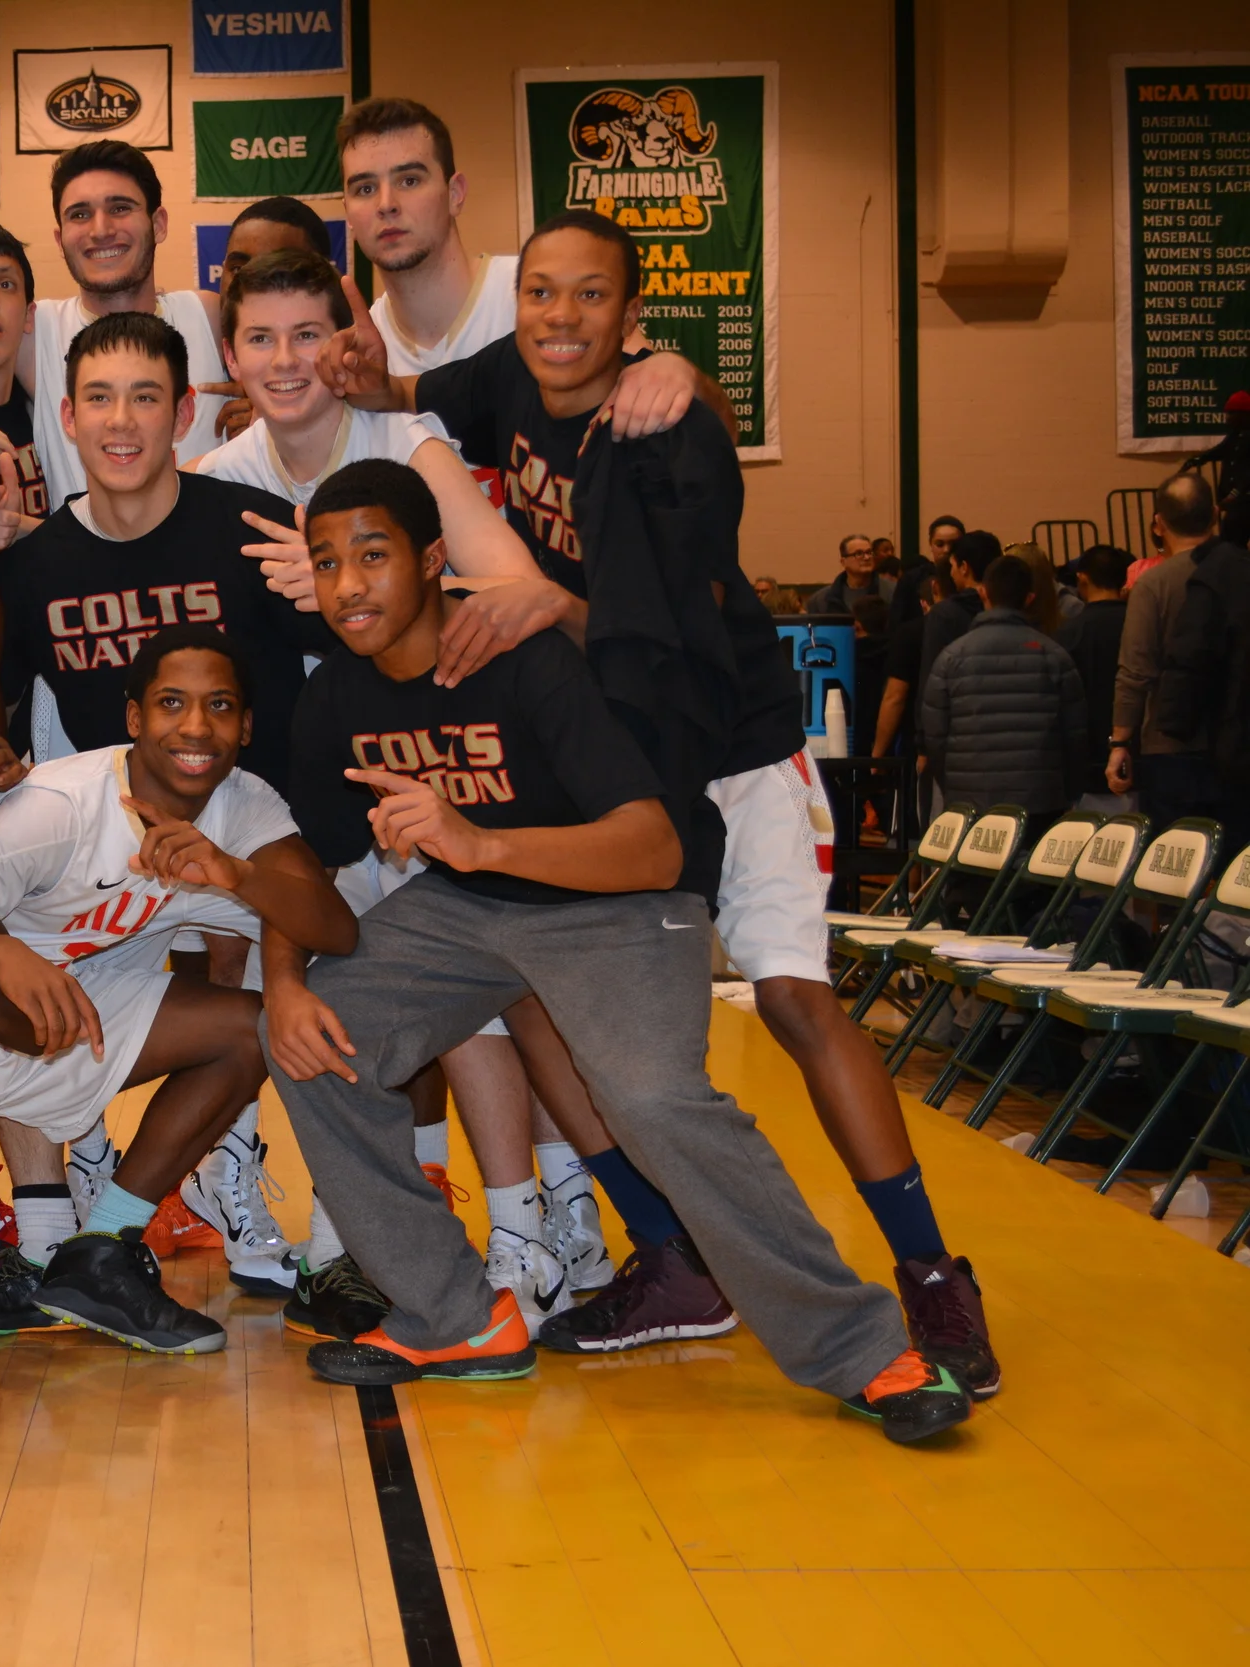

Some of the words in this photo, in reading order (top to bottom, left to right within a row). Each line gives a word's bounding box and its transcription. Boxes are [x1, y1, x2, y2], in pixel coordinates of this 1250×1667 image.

[206, 11, 332, 37] YESHIVA
[1138, 84, 1199, 101] NCAA
[60, 107, 128, 120] SKYLINE
[1141, 116, 1212, 128] BASEBALL
[1141, 132, 1203, 144] OUTDOOR
[230, 136, 307, 160] SAGE
[1143, 148, 1211, 160] WOMEN'S
[1143, 165, 1185, 177] MEN'S
[575, 164, 718, 200] FARMINGDALE
[1144, 182, 1211, 194] WOMEN'S
[616, 199, 676, 208] STATE
[1142, 198, 1212, 210] SOFTBALL
[595, 194, 704, 227] RAMS
[1143, 215, 1185, 227] MEN'S
[1189, 214, 1223, 226] GOLF
[1143, 231, 1213, 243] BASEBALL
[1145, 247, 1211, 259] WOMEN'S
[1145, 263, 1211, 275] WOMEN'S
[639, 271, 751, 296] AMENT
[1144, 281, 1193, 292] INDOOR
[1199, 280, 1246, 292] TRACK
[1145, 297, 1186, 309] MEN'S
[1190, 296, 1224, 308] GOLF
[717, 305, 752, 318] 2003
[1145, 313, 1215, 325] BASEBALL
[717, 322, 752, 334] 2005
[1146, 330, 1214, 341] WOMEN'S
[717, 338, 752, 351] 2006
[1146, 346, 1195, 358] INDOOR
[1201, 346, 1248, 357] TRACK
[718, 355, 753, 367] 2007
[1146, 363, 1180, 374] GOLF
[719, 371, 753, 384] 2007
[1147, 379, 1217, 391] BASEBALL
[724, 388, 753, 399] 007
[1147, 395, 1217, 407] SOFTBALL
[1147, 412, 1190, 424] MEN'S
[46, 581, 222, 637] COLTS
[352, 722, 504, 772] COLTS
[969, 826, 1008, 854] RAMS
[1088, 836, 1126, 868] RAMS
[1149, 843, 1196, 878] RAMS
